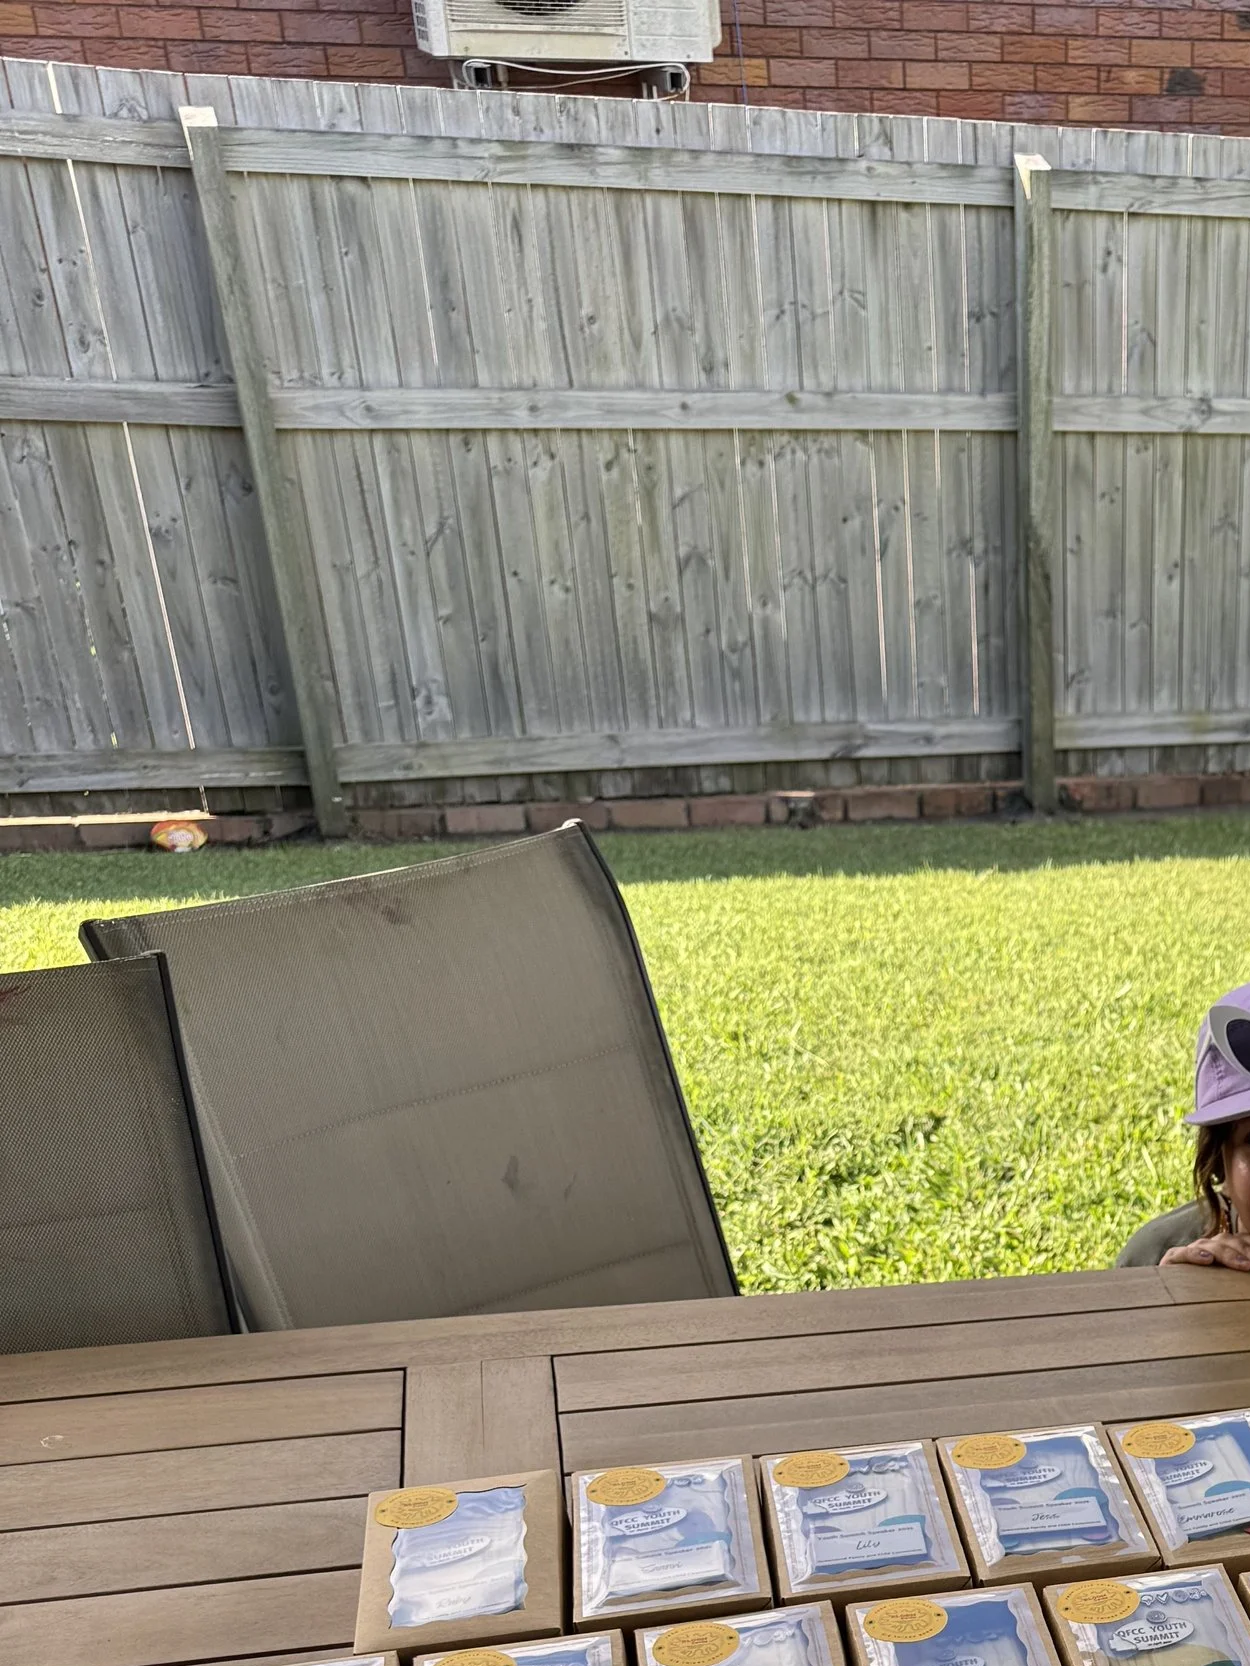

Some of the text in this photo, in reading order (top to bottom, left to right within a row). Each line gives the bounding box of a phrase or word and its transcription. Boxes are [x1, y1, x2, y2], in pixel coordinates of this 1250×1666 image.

[644, 1509, 680, 1520] YOUTH
[625, 1519, 671, 1530] SUMMIT
[1117, 1622, 1187, 1638] QFCC YOUTH
[1133, 1631, 1180, 1644] SUMMIT
